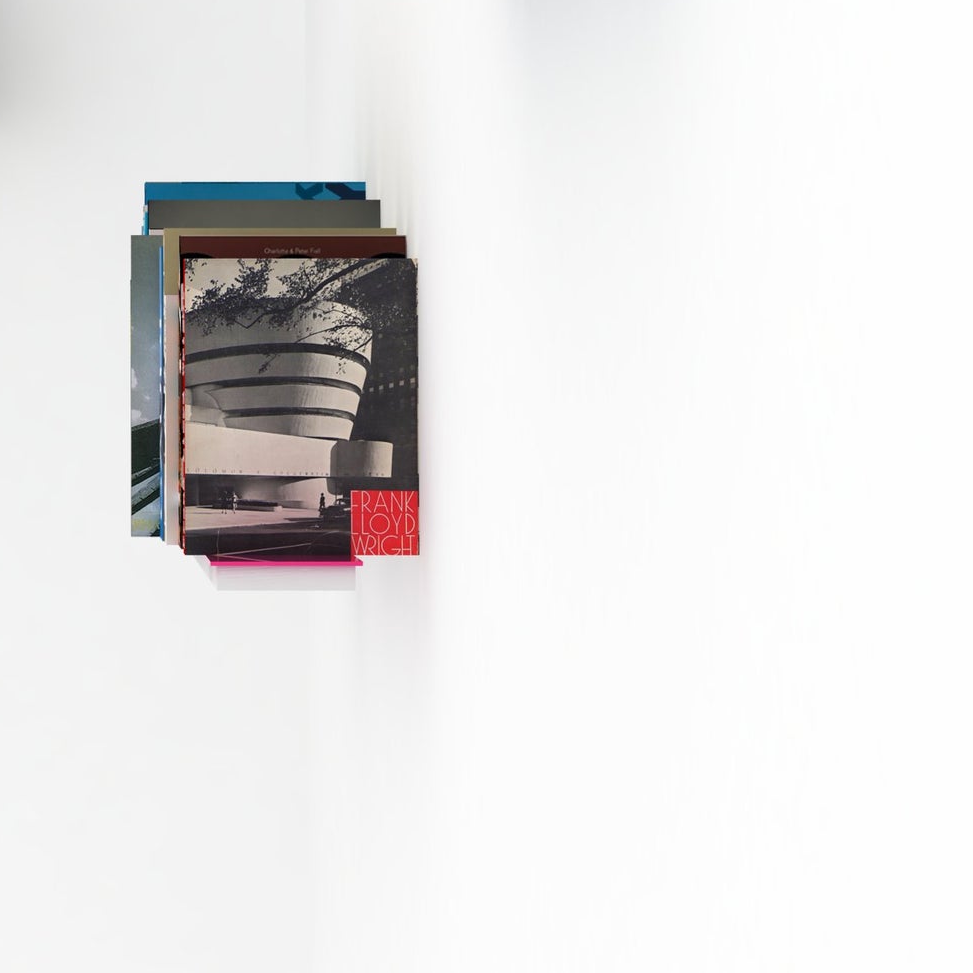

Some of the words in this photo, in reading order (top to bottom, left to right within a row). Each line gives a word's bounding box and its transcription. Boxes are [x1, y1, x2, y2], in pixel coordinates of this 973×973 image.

[351, 490, 415, 513] FRANK
[351, 513, 416, 535] LLOYD
[351, 534, 416, 555] WRIGHT
